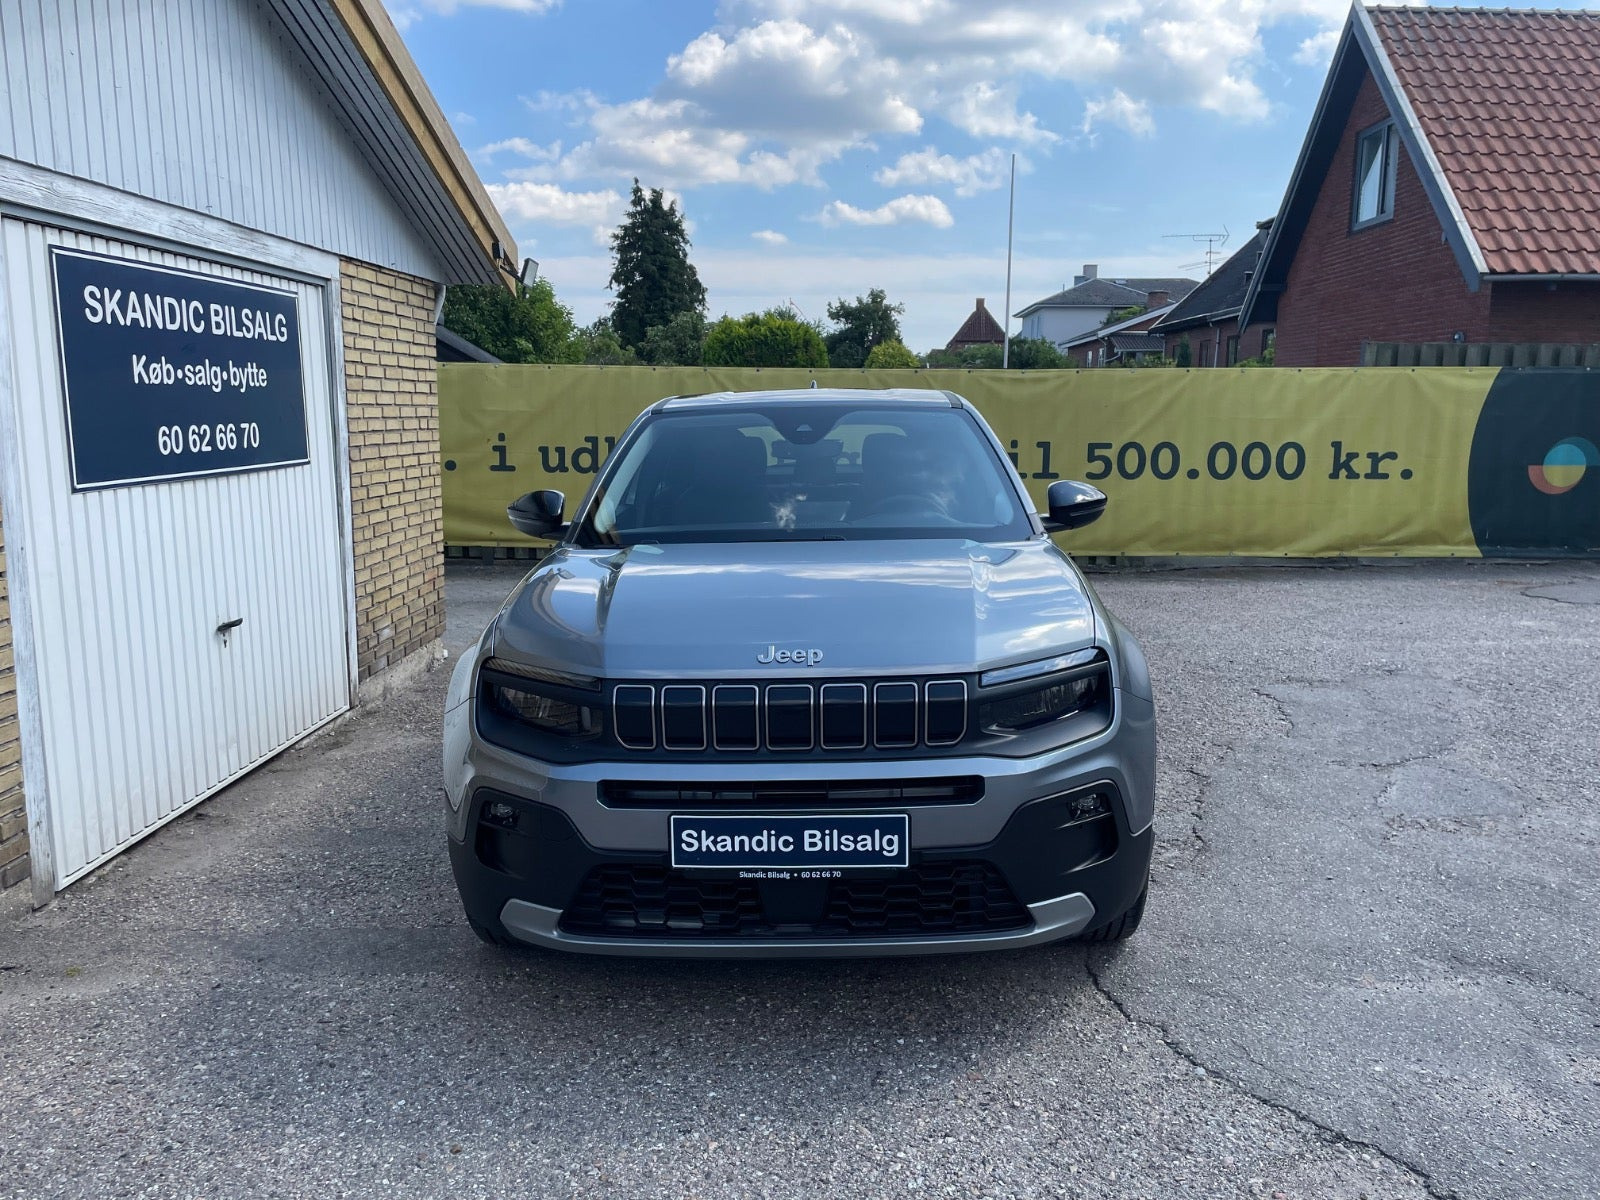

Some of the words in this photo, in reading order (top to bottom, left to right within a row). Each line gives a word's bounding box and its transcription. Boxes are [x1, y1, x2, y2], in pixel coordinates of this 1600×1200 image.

[83, 285, 205, 334] SKANDIC
[210, 304, 288, 342] BILSALG
[158, 425, 184, 455] 60
[188, 424, 212, 453] 62
[215, 423, 238, 450] 66
[240, 422, 260, 448] 70
[488, 432, 516, 472] i
[1085, 441, 1305, 480] 500.000
[1328, 440, 1413, 480] kr.
[757, 645, 824, 666] Jeep
[681, 829, 794, 852] Skandic
[803, 829, 899, 856] Bilsalg
[767, 871, 791, 879] Bilsalg
[831, 870, 842, 878] 70
